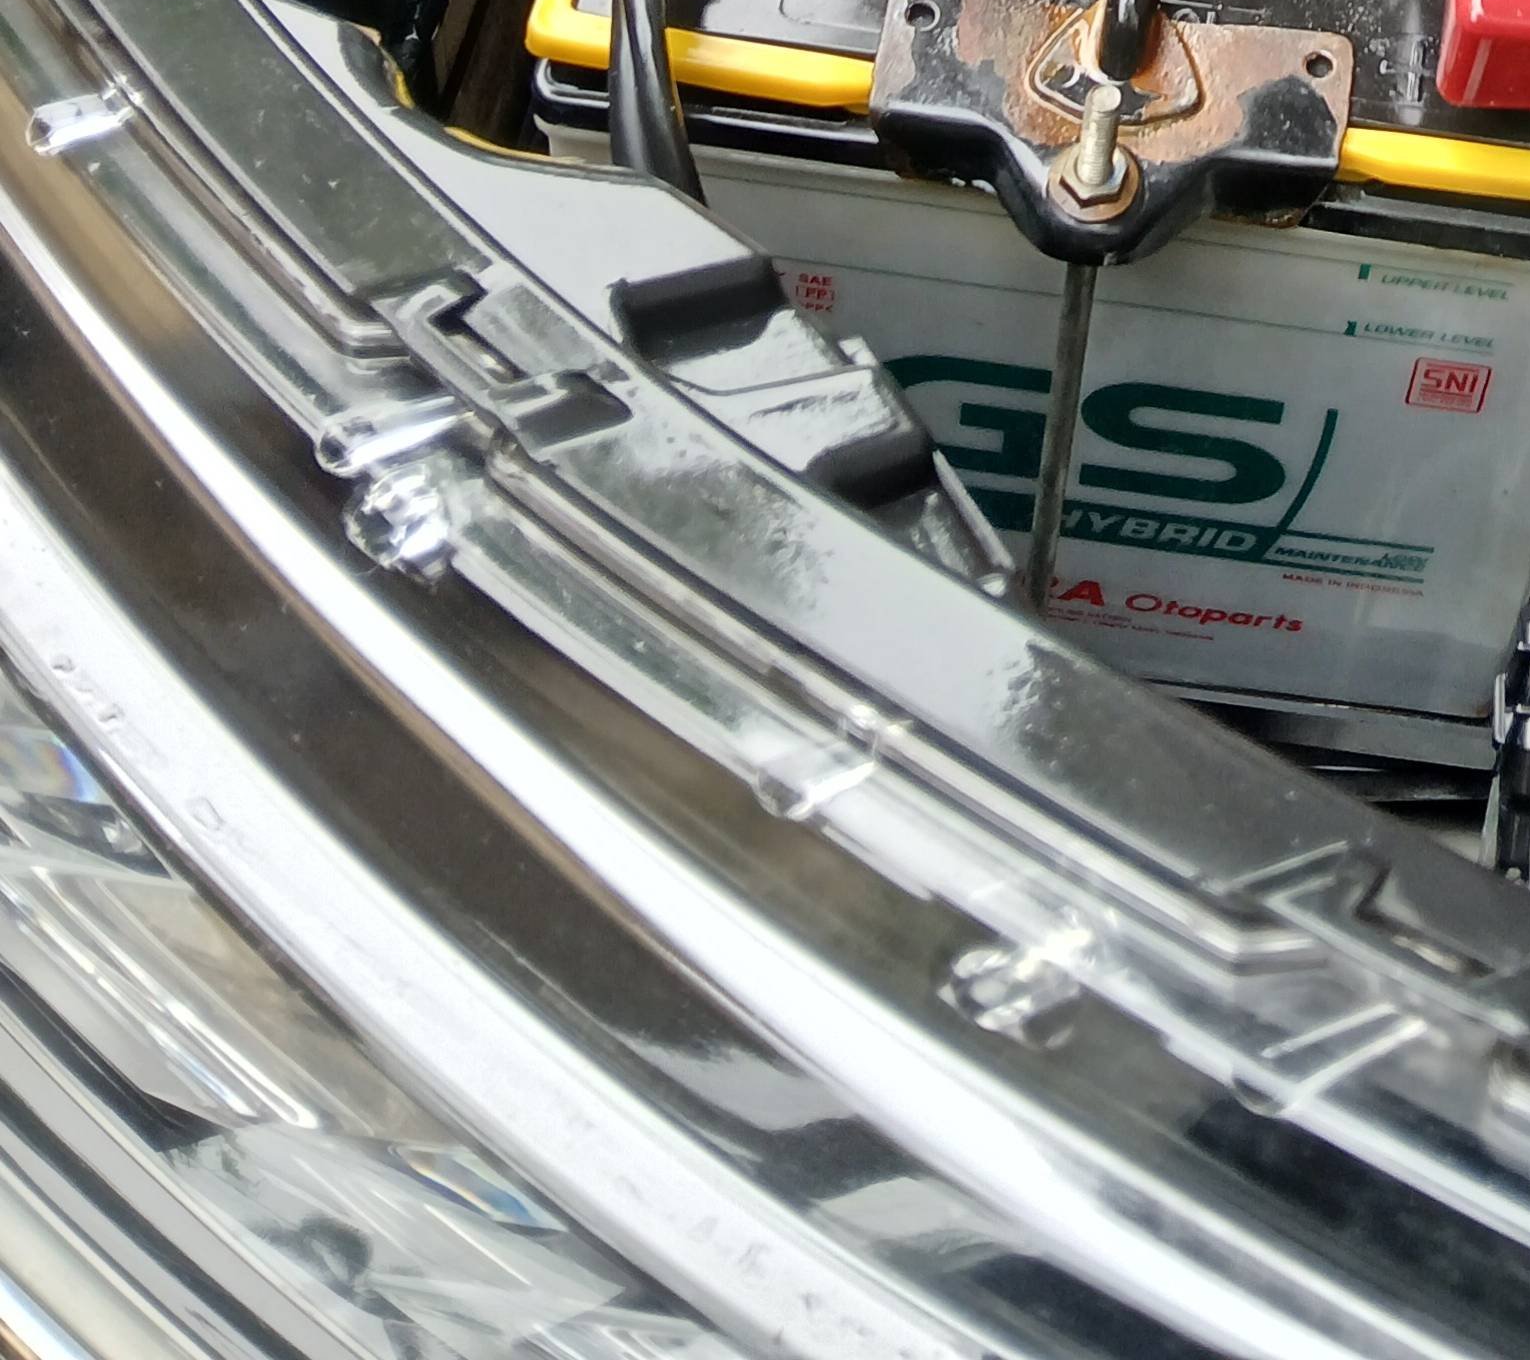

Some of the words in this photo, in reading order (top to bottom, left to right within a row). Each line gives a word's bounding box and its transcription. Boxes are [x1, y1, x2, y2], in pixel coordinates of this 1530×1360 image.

[1453, 284, 1509, 301] LEVEL
[1363, 321, 1434, 340] LOWER
[1440, 333, 1495, 348] LEVEL
[1423, 367, 1481, 394] SNI
[883, 355, 1286, 504] GS
[1125, 592, 1305, 633] Otoparts
